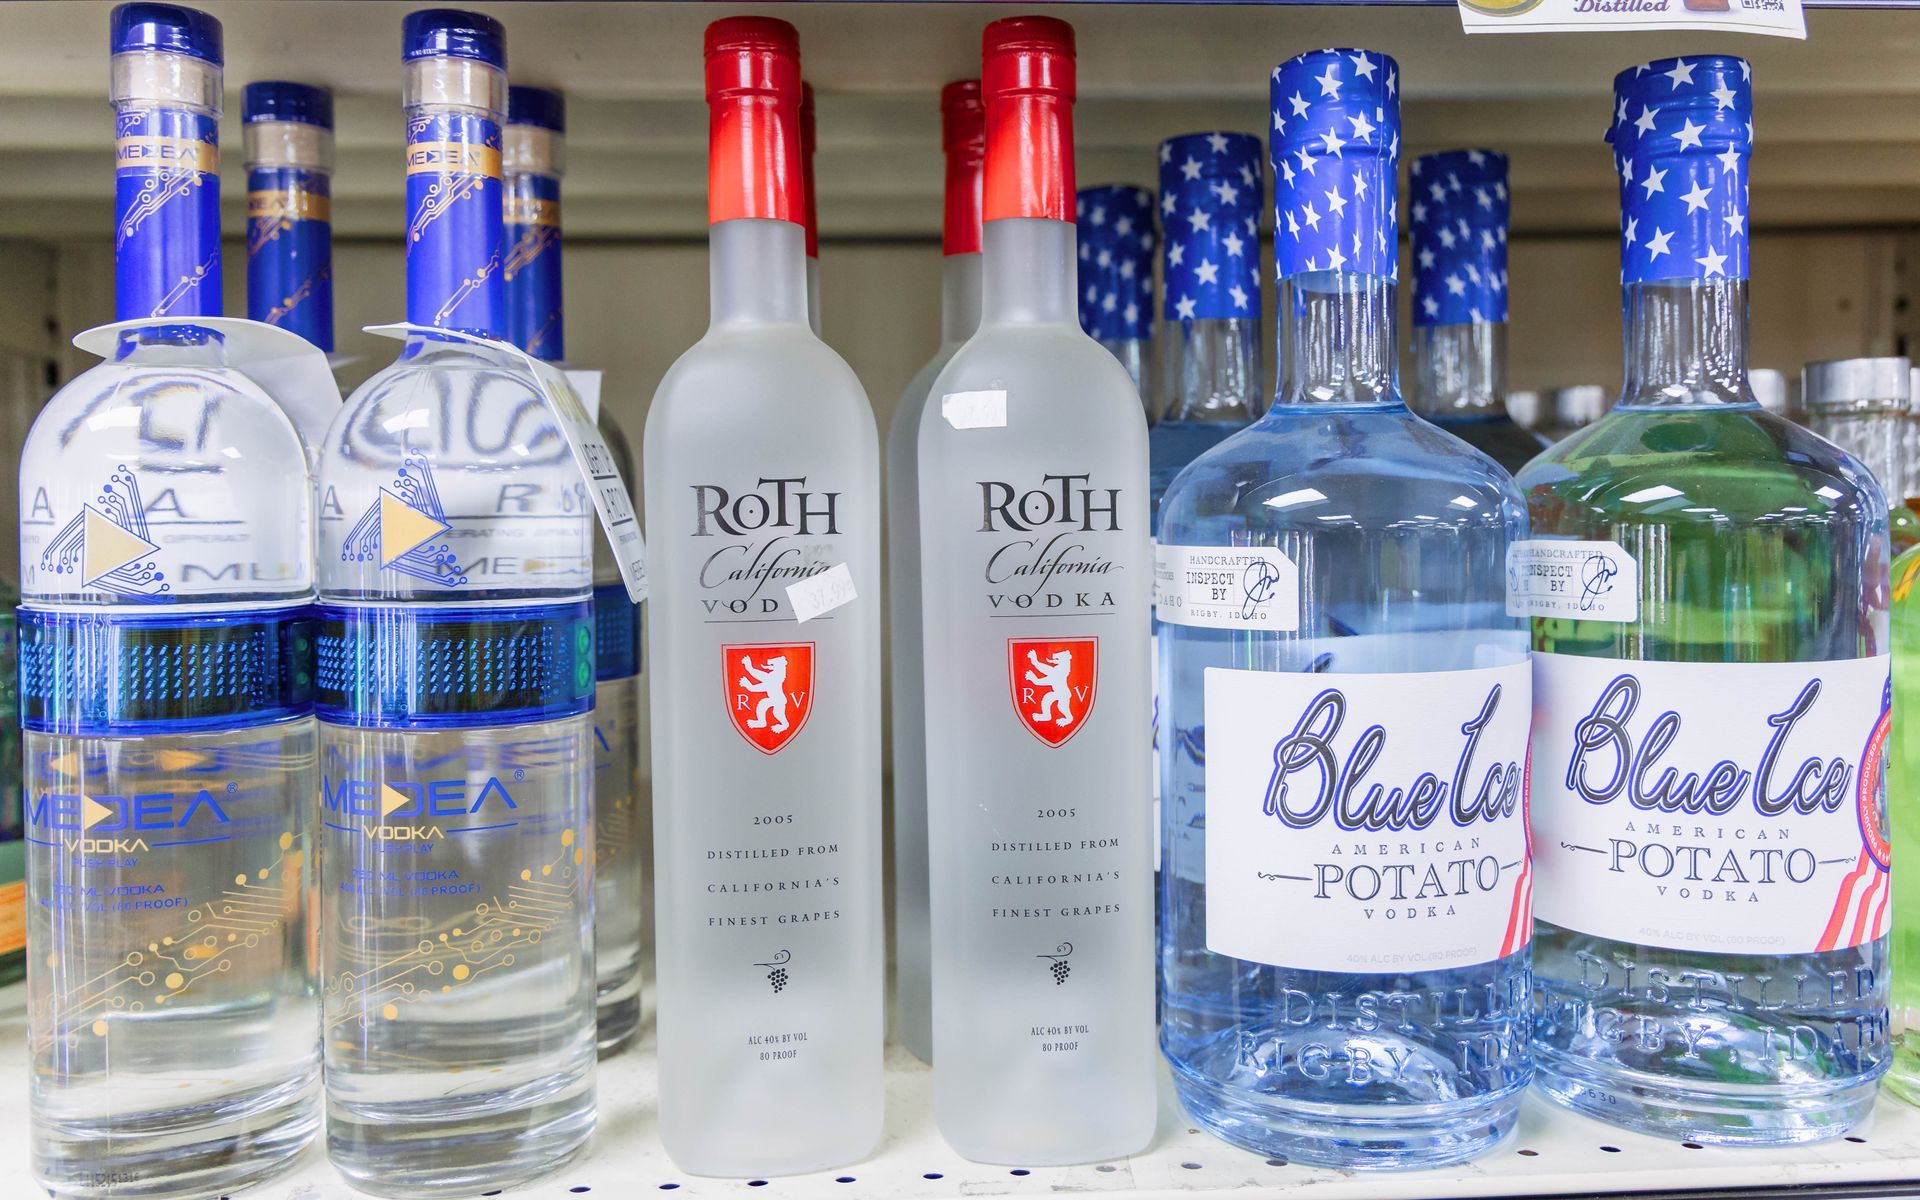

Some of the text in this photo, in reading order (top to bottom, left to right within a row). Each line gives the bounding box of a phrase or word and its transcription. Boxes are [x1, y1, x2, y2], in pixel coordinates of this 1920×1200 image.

[1573, 0, 1671, 13] Distilled
[985, 532, 1124, 603] California
[1190, 555, 1265, 566] HANDCRAFTED
[699, 536, 831, 608] California
[1186, 571, 1235, 586] INSPECT
[1550, 580, 1565, 592] BY
[988, 592, 1116, 609] VODKA
[1211, 588, 1227, 601] BY
[737, 691, 805, 711] R V
[1022, 686, 1089, 704] R V
[1566, 674, 1751, 815] Blue
[1752, 678, 1853, 817] Ice
[1263, 688, 1448, 832] Blue
[1450, 683, 1521, 827] Ice
[753, 814, 793, 825] 2005
[1037, 808, 1076, 818] 2005
[362, 825, 445, 840] VODKA
[1625, 821, 1791, 840] AMERICAN
[64, 838, 149, 853] VODKA
[707, 844, 838, 859] DISTILLED FROM
[992, 838, 1119, 851] DISTILLED FROM
[1332, 837, 1480, 855] AMERICAN
[1608, 838, 1817, 884] POTATO
[708, 877, 839, 893] CALIFORNIA'S
[992, 871, 1119, 884] CALIFORNIA'S
[1313, 855, 1499, 901] POTATO
[1657, 886, 1759, 903] VODKA
[709, 910, 840, 926] FINEST GRAPES
[993, 904, 1120, 917] FINEST GRAPES
[1364, 905, 1456, 919] VODKA
[1575, 950, 1876, 1013] DISTILLED
[1031, 1025, 1089, 1036] ALC 40% BY VOL
[749, 1032, 807, 1045] ALC 40% BY VOL
[1042, 1042, 1079, 1052] 80 PROOF
[760, 1050, 797, 1061] 80 PROOF
